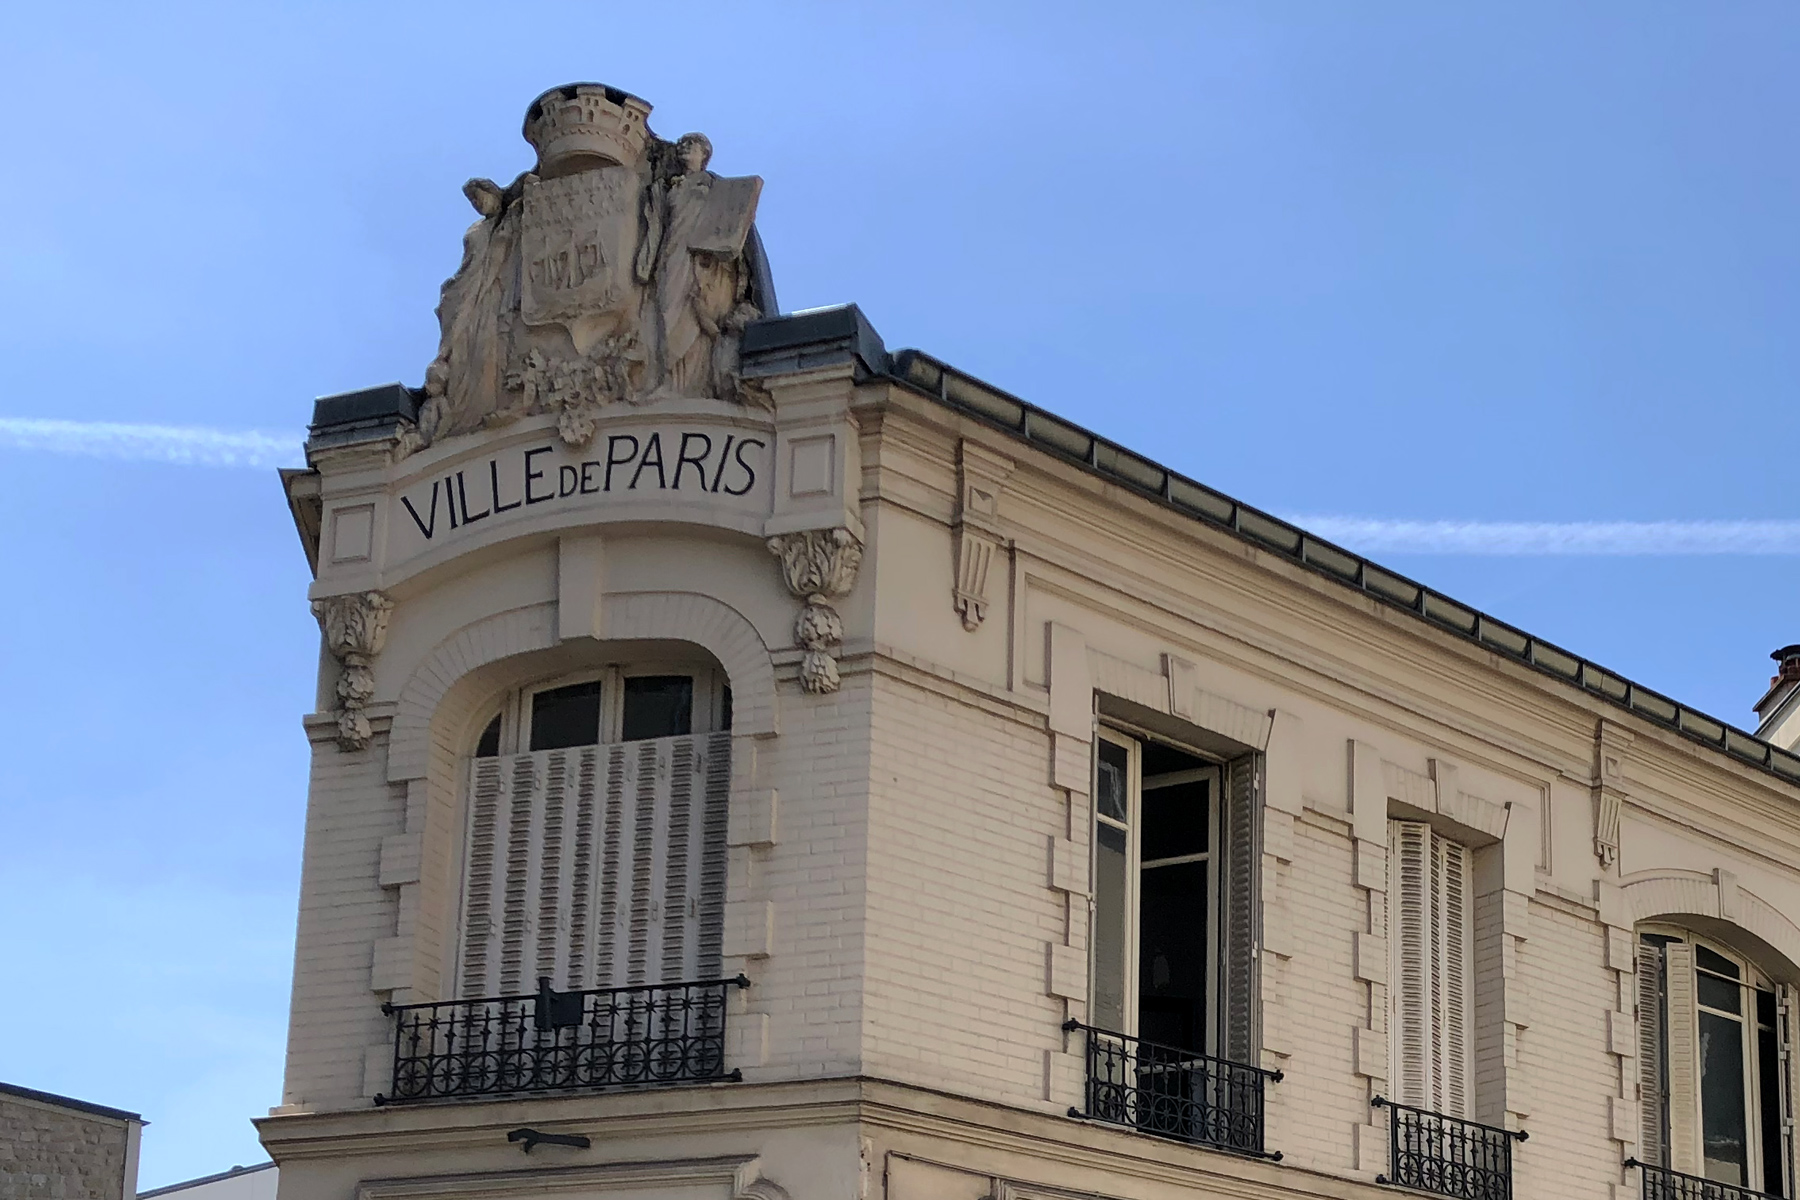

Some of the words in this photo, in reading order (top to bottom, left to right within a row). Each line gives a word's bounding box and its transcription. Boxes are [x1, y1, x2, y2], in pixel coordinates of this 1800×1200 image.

[400, 445, 558, 540] VILLE
[559, 460, 601, 498] DE
[602, 431, 766, 497] PARIS
